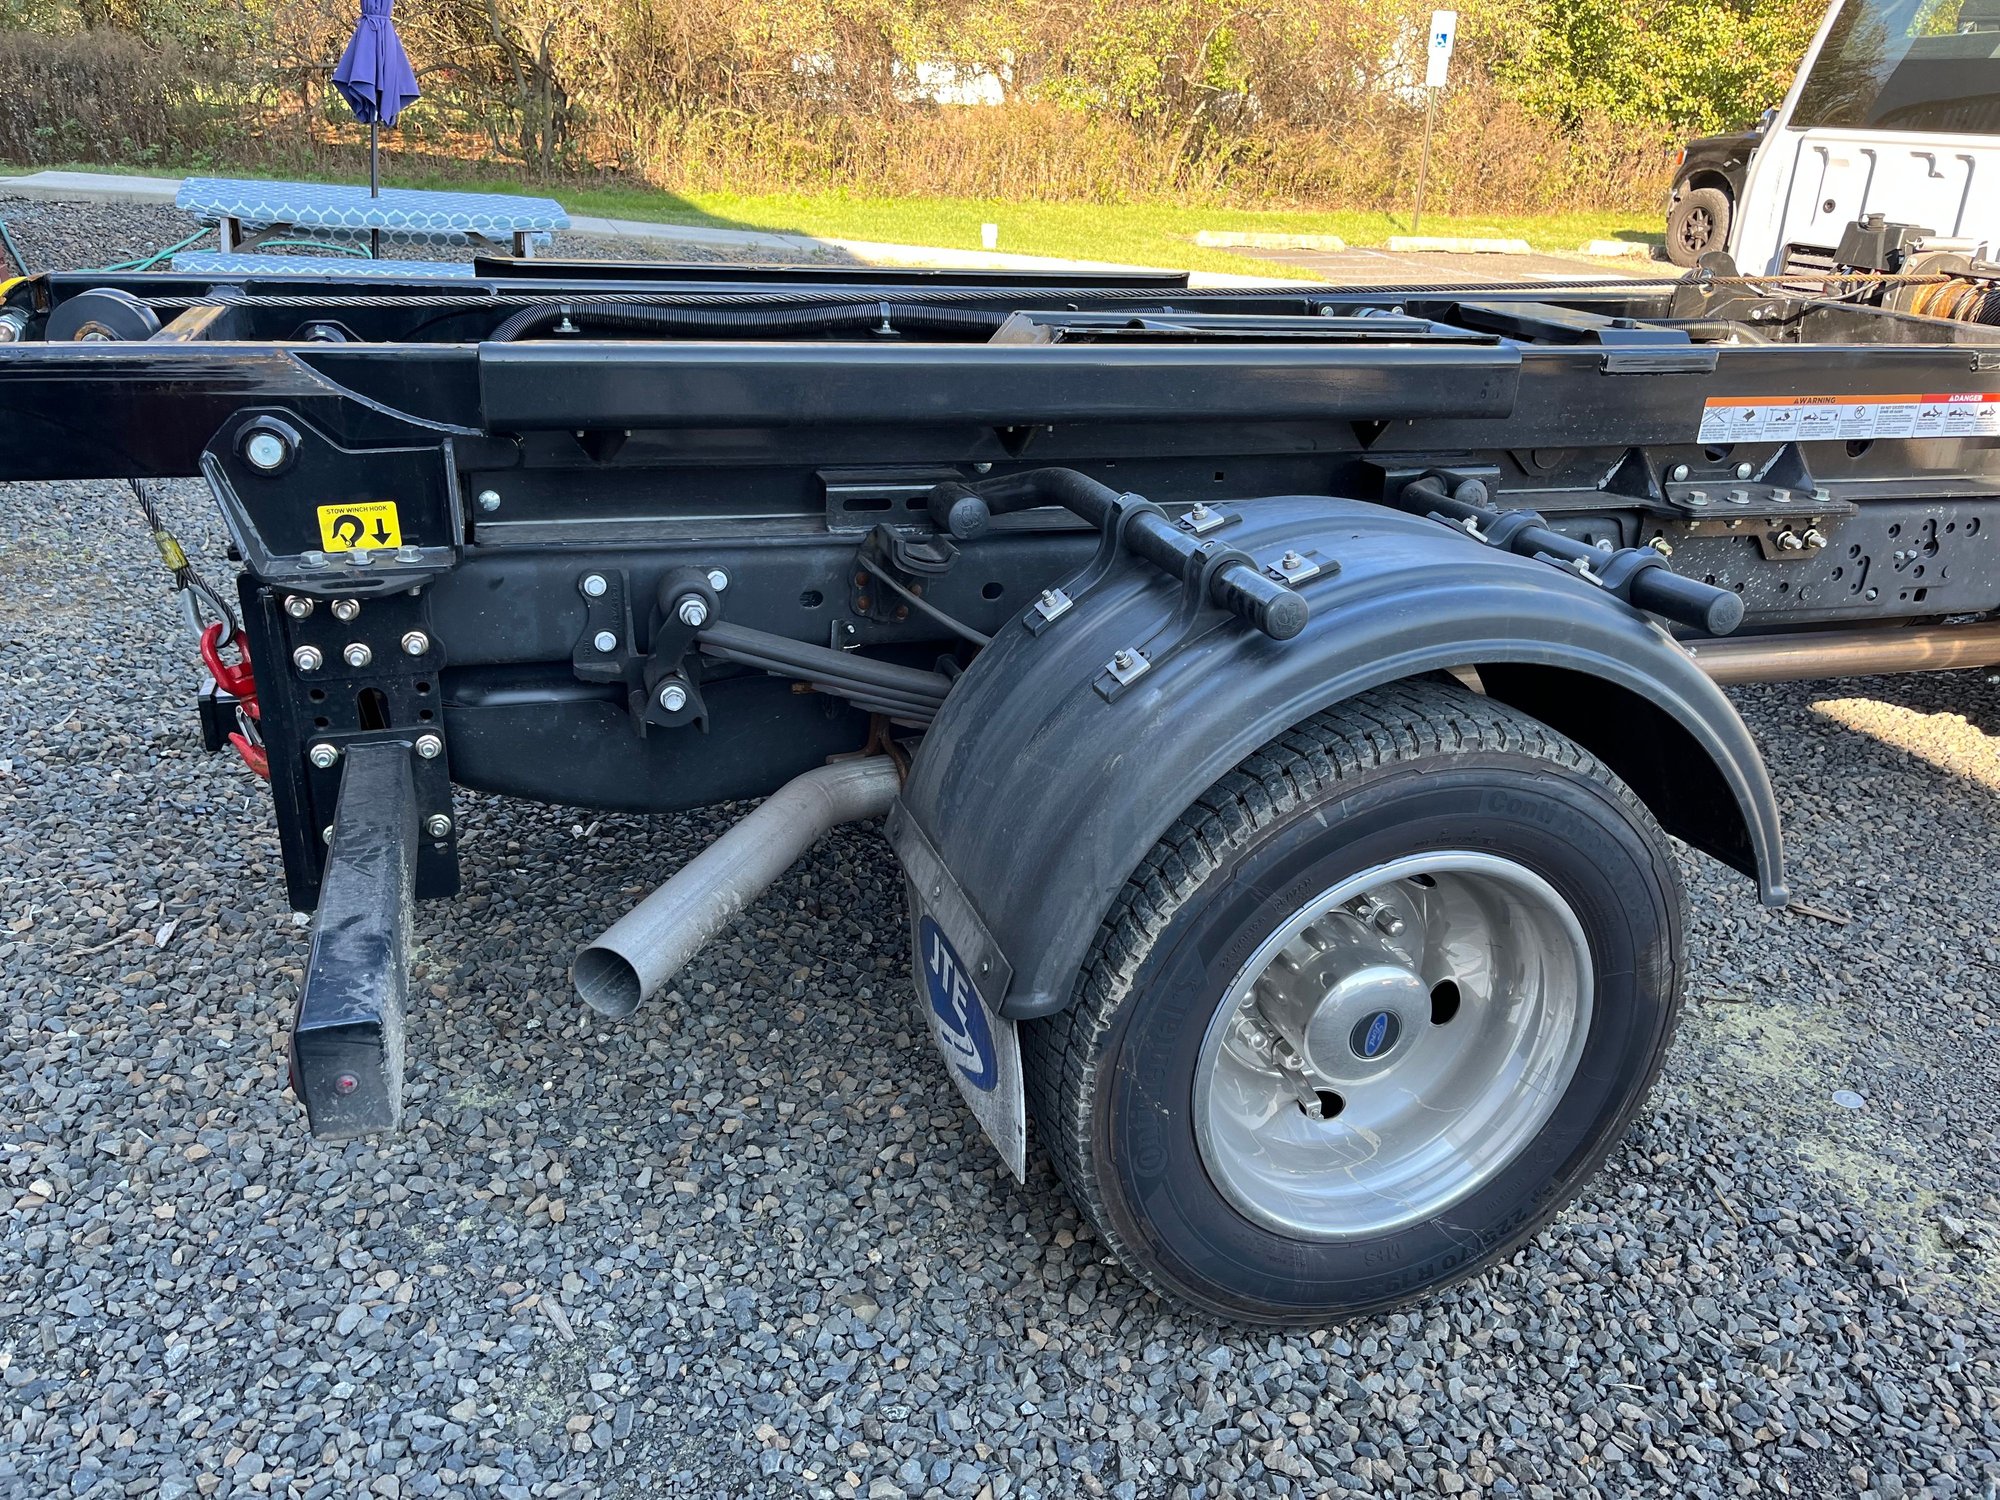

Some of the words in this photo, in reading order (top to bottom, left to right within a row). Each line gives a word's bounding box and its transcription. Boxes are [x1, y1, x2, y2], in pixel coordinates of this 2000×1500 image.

[1954, 394, 1983, 402] DANGER
[1488, 791, 1558, 824] Conti
[930, 932, 968, 1026] JTE
[1369, 1022, 1384, 1047] Ford
[1131, 1003, 1187, 1179] Continental
